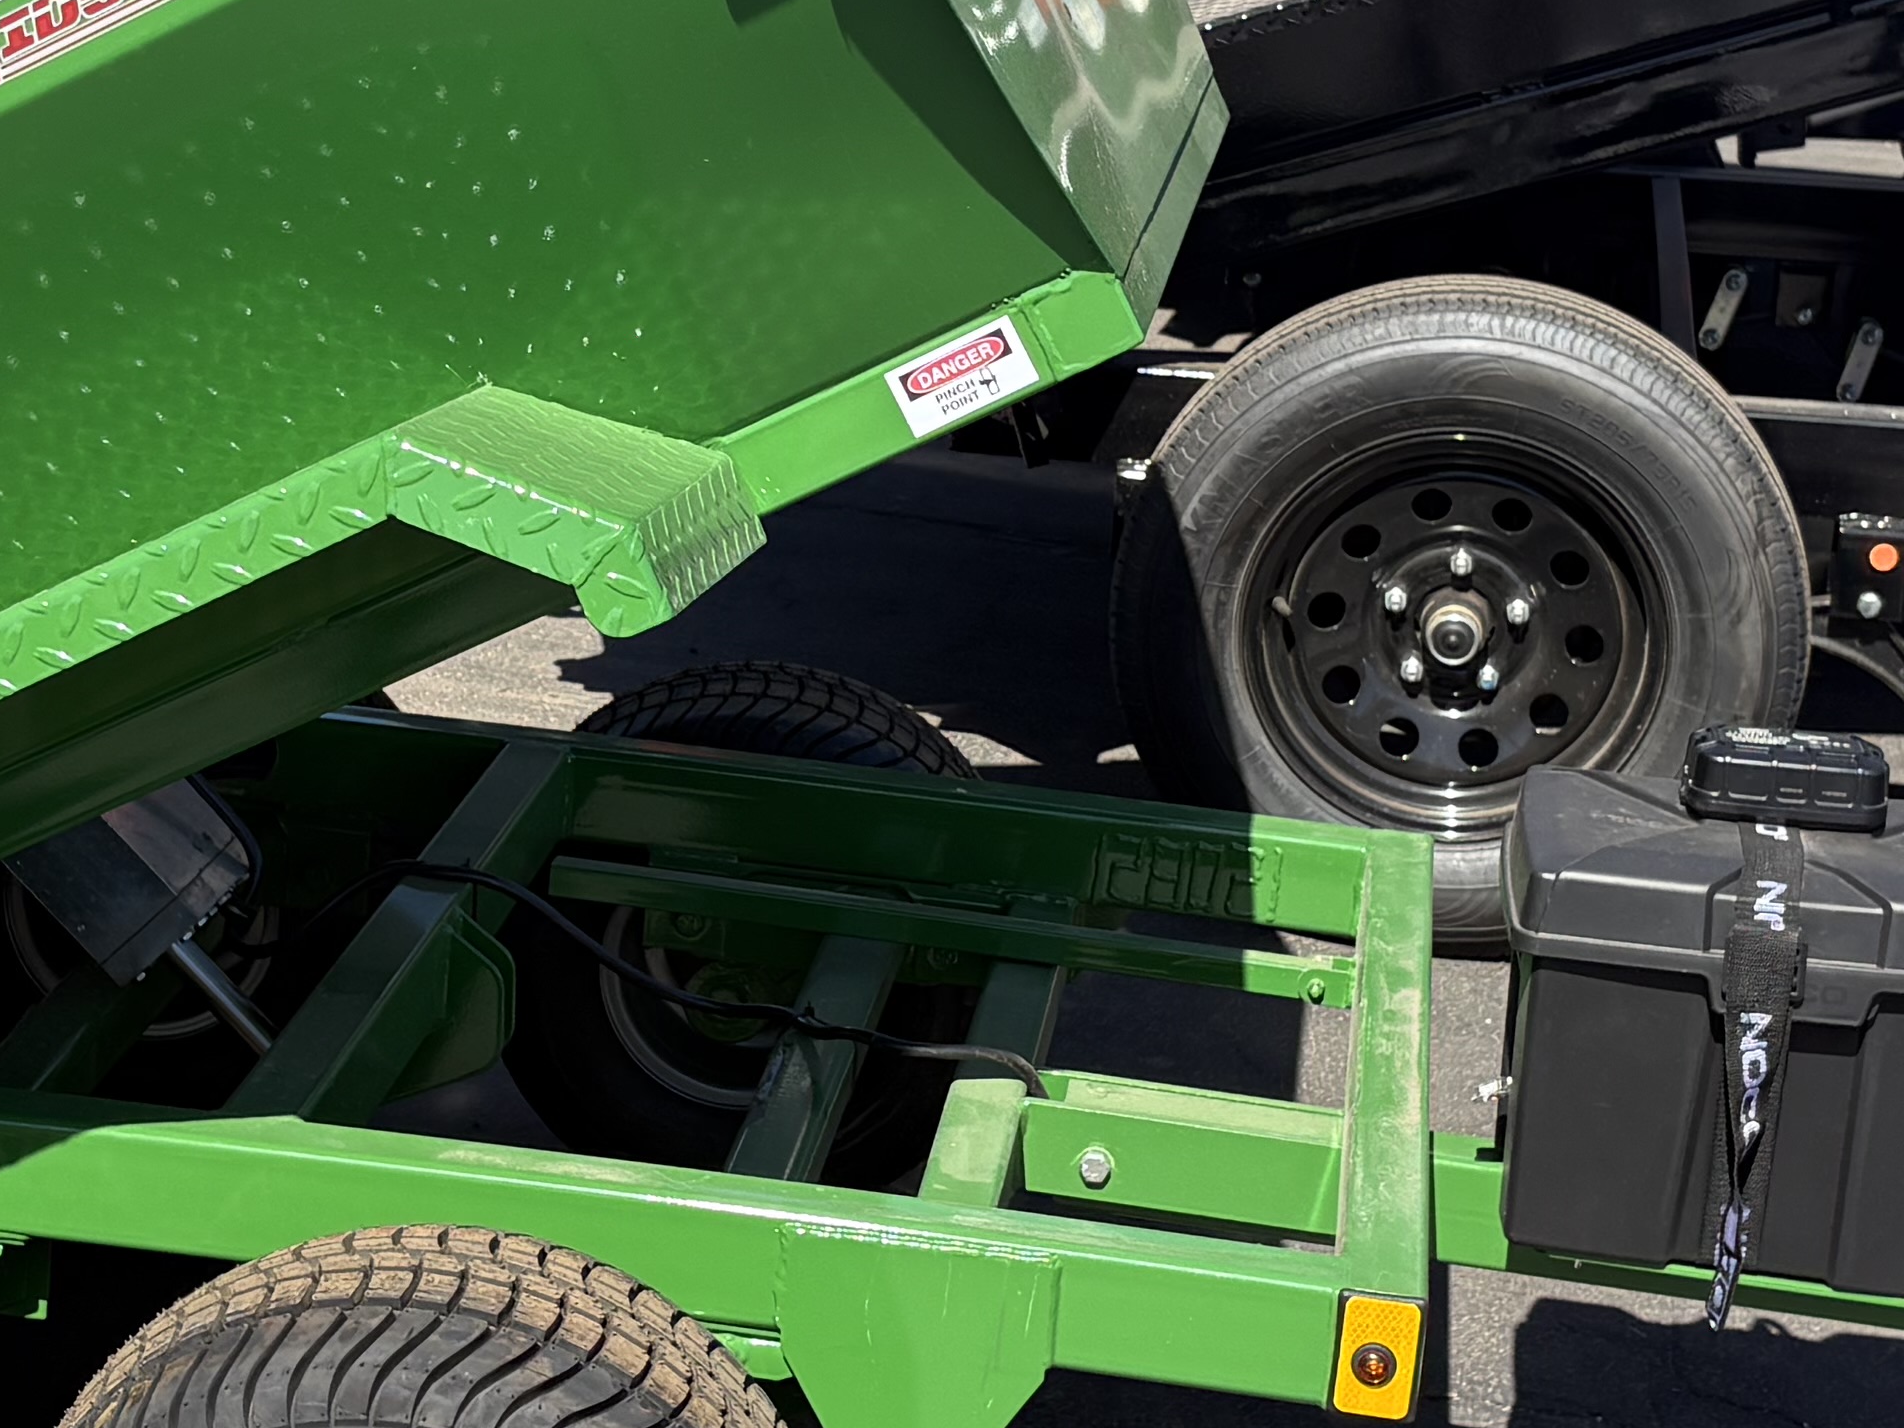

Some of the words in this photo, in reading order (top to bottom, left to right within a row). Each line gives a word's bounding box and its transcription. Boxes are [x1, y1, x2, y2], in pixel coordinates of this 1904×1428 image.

[917, 341, 995, 390] DANGER
[935, 377, 976, 405] PINCH
[941, 388, 980, 416] POINT
